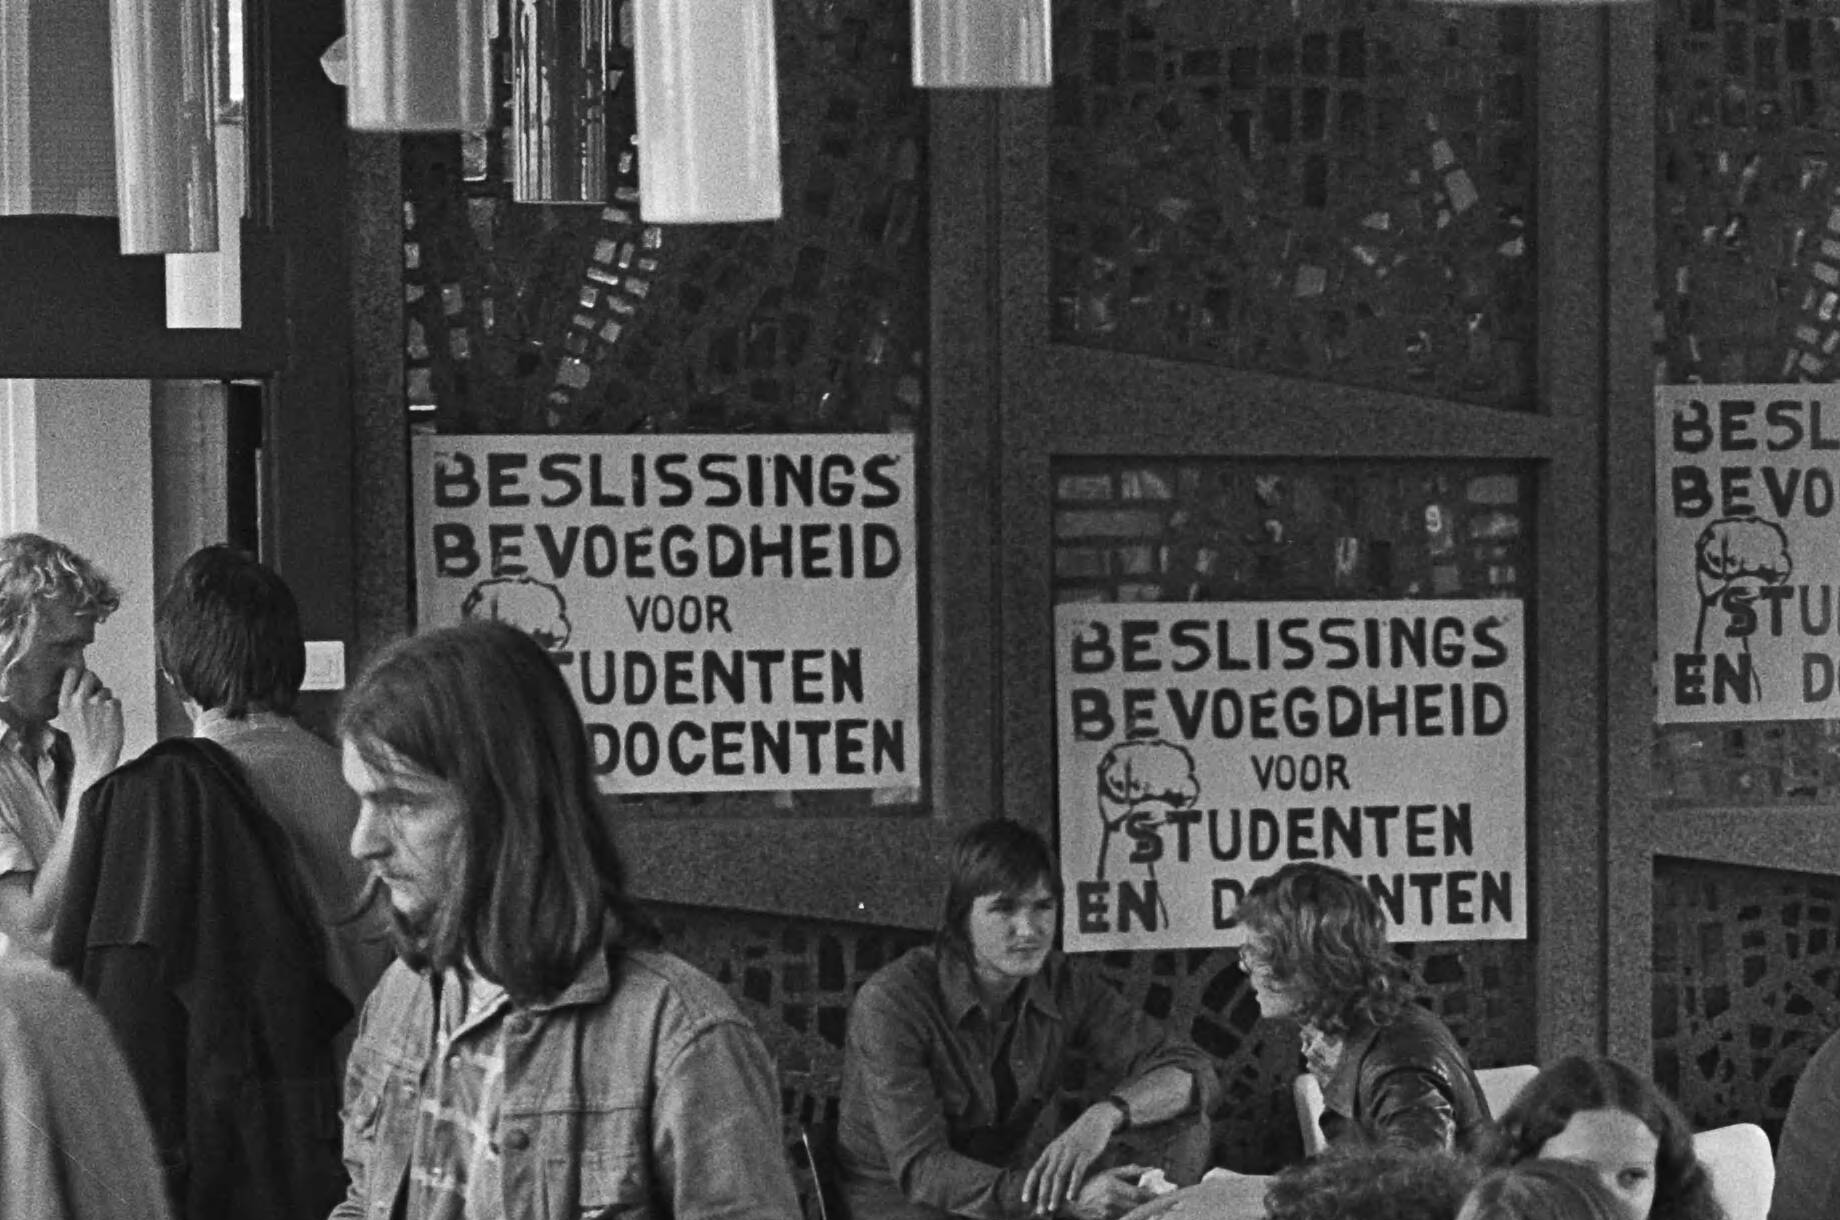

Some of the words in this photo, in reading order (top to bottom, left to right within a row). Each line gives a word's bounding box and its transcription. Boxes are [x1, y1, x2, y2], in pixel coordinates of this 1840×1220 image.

[433, 452, 900, 508] BESLISSINGS
[433, 523, 901, 578] BEVOEGDHEID
[626, 595, 733, 633] VOOR
[1071, 615, 1508, 673] BESLISSINGS
[1673, 652, 1752, 705] EN
[1070, 682, 1509, 741] BEVOEGDHEID
[584, 719, 904, 777] DOCENTEN
[1251, 753, 1350, 791] VOOR
[1126, 802, 1474, 863] STUDENTEN
[1077, 879, 1158, 934] EN
[1212, 870, 1512, 930] DNTEN
